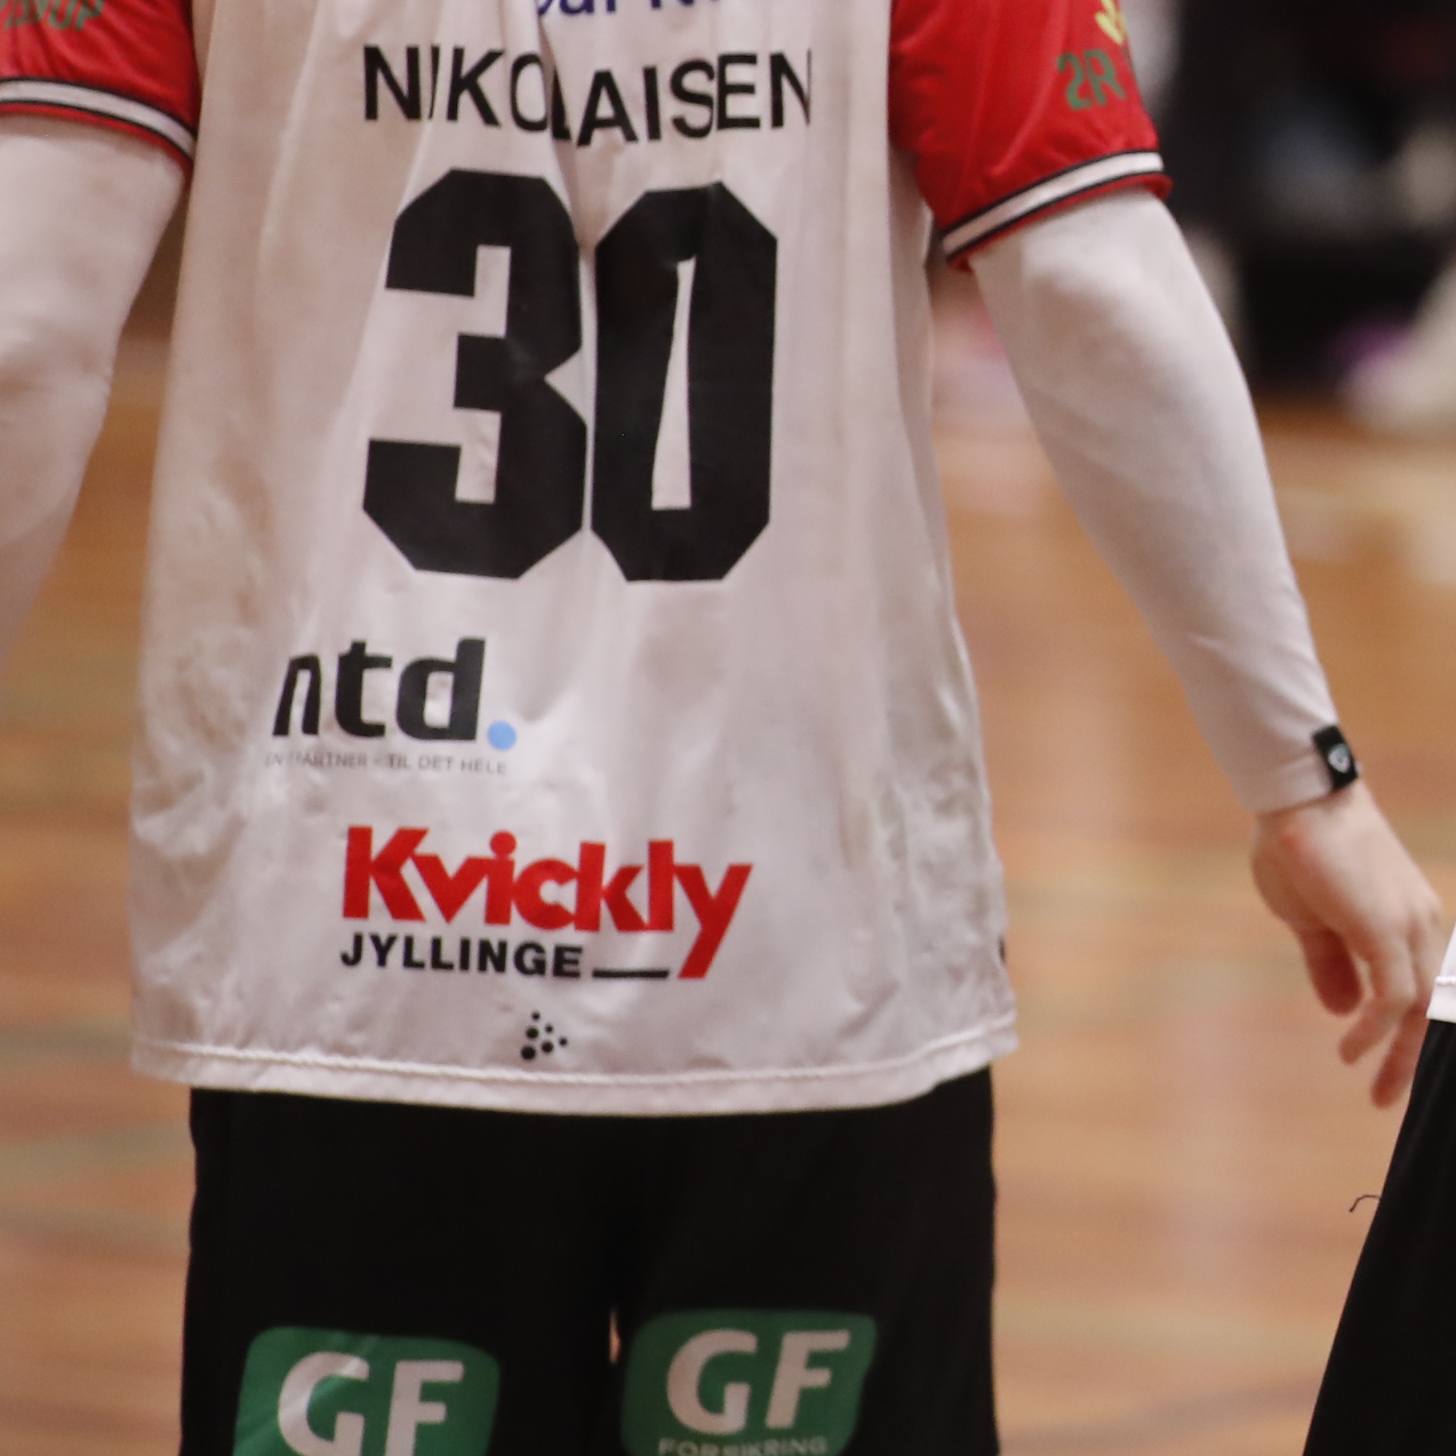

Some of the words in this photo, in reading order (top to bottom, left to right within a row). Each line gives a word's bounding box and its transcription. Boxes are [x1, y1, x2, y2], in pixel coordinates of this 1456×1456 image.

[362, 168, 778, 582] 30
[341, 932, 584, 979] JYLLINGE
[342, 825, 753, 981] Kvickly
[277, 1351, 464, 1456] GF
[666, 1329, 851, 1435] GF
